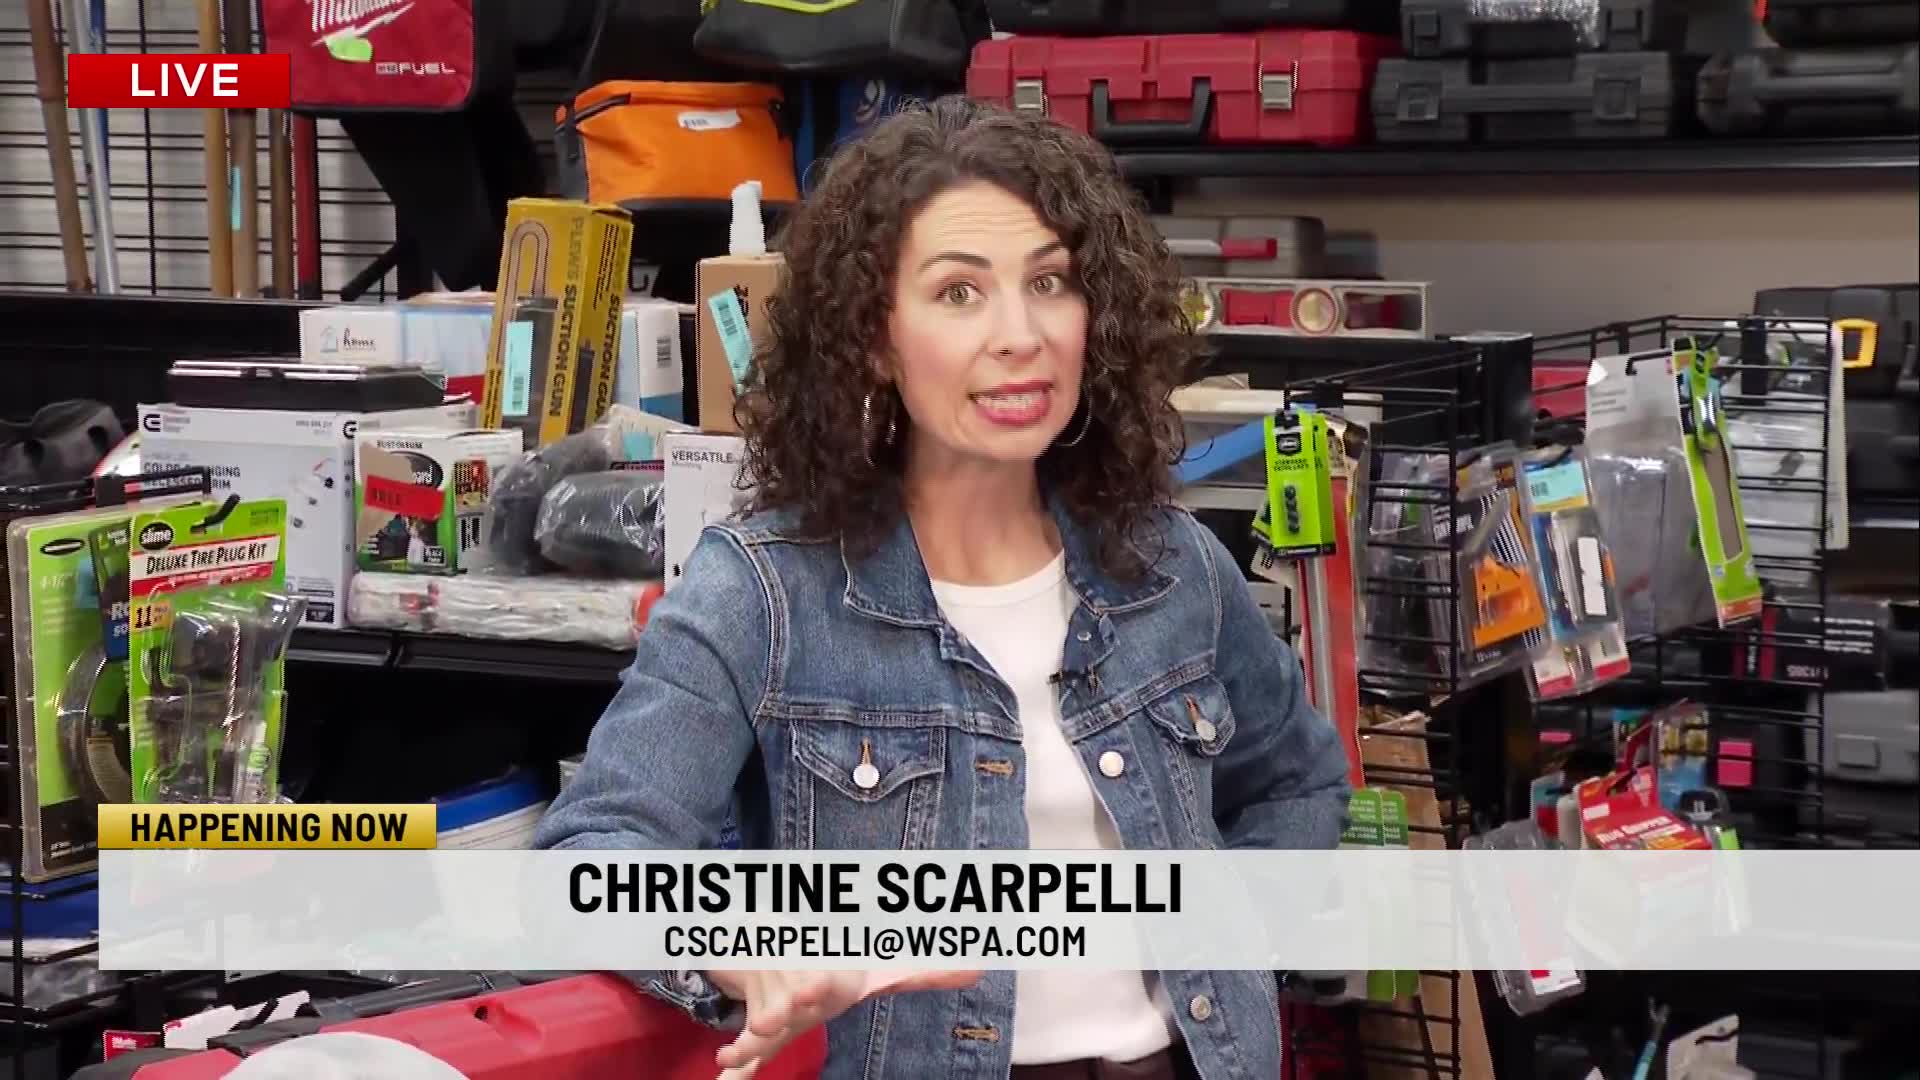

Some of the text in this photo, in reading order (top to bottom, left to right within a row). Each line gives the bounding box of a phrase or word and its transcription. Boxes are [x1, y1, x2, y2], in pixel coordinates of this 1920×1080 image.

[399, 62, 457, 75] FUEL
[555, 284, 578, 372] SUCTION
[599, 292, 621, 381] SUCTION
[549, 372, 567, 417] GUN
[671, 449, 735, 464] VERSATILE
[142, 527, 173, 545] slime
[145, 542, 268, 576] DELUXE TIRE PLUG KIT
[134, 604, 152, 629] 11
